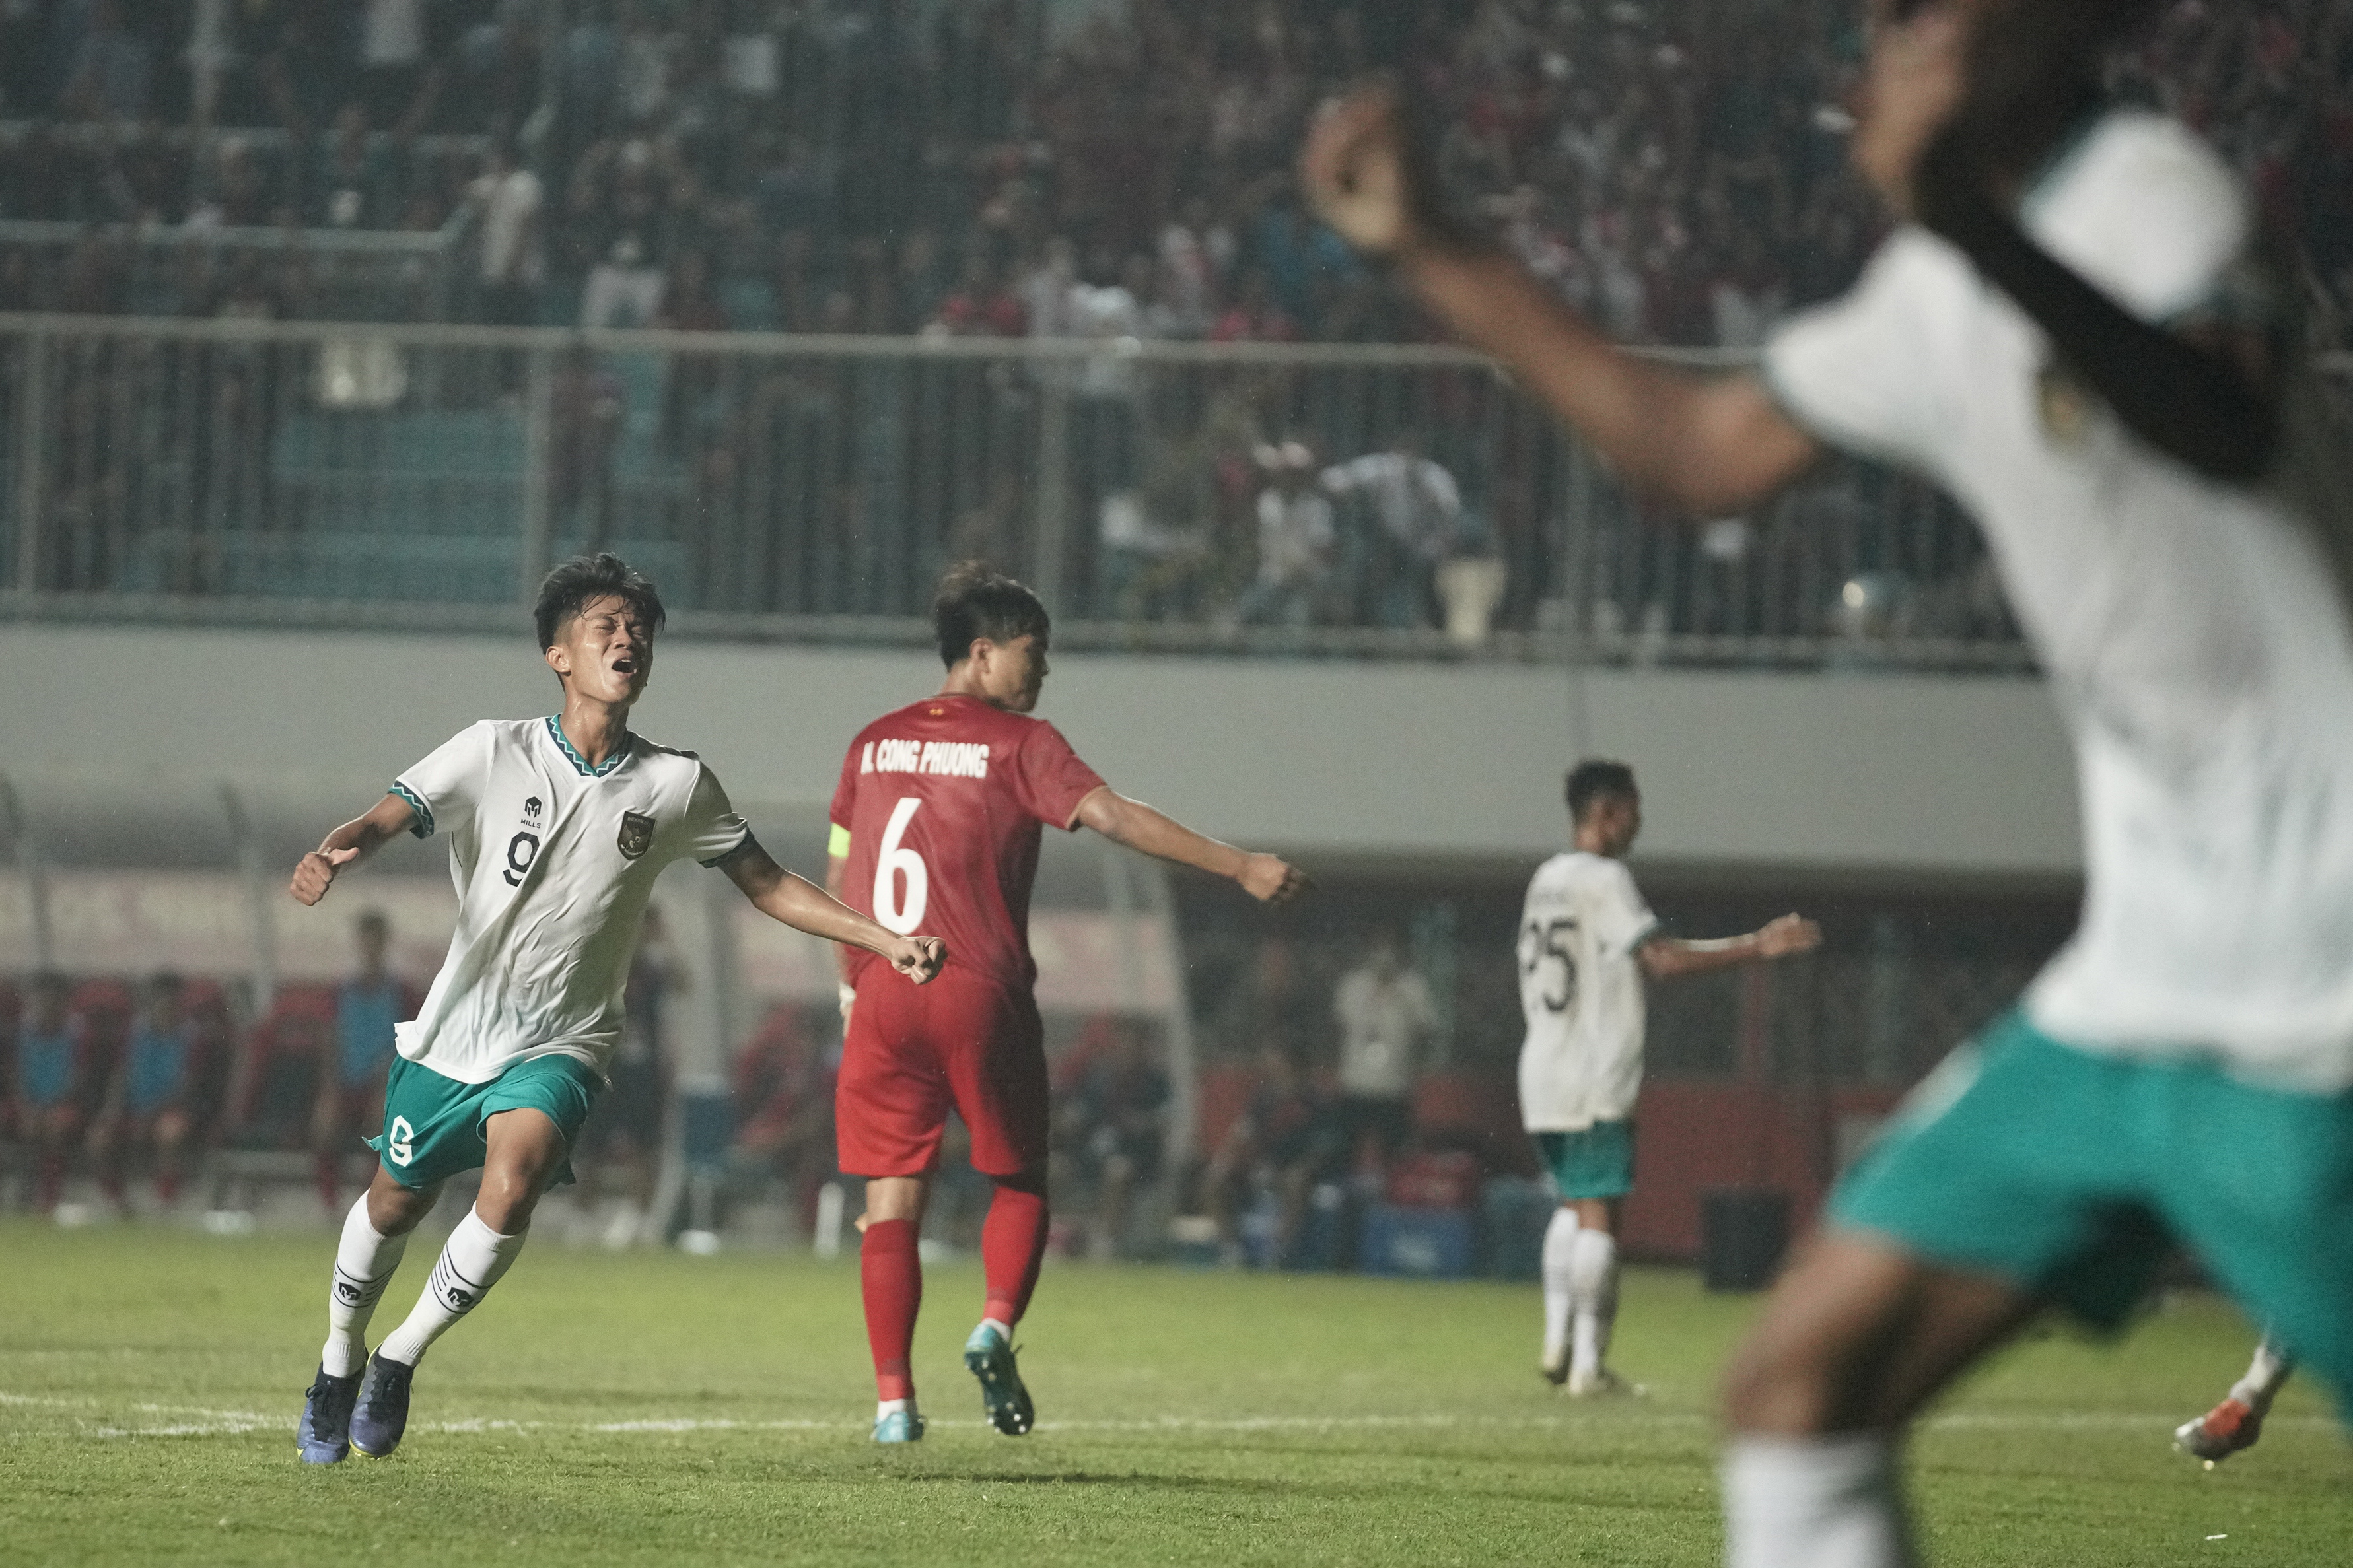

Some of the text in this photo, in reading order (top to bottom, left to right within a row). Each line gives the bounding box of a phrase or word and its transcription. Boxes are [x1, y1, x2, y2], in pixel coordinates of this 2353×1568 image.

[876, 738, 921, 774] CONG
[919, 741, 990, 779] PHUONG
[520, 818, 542, 829] MILLS
[503, 831, 540, 887] 9
[872, 797, 928, 936] 6
[388, 1114, 415, 1167] 9
